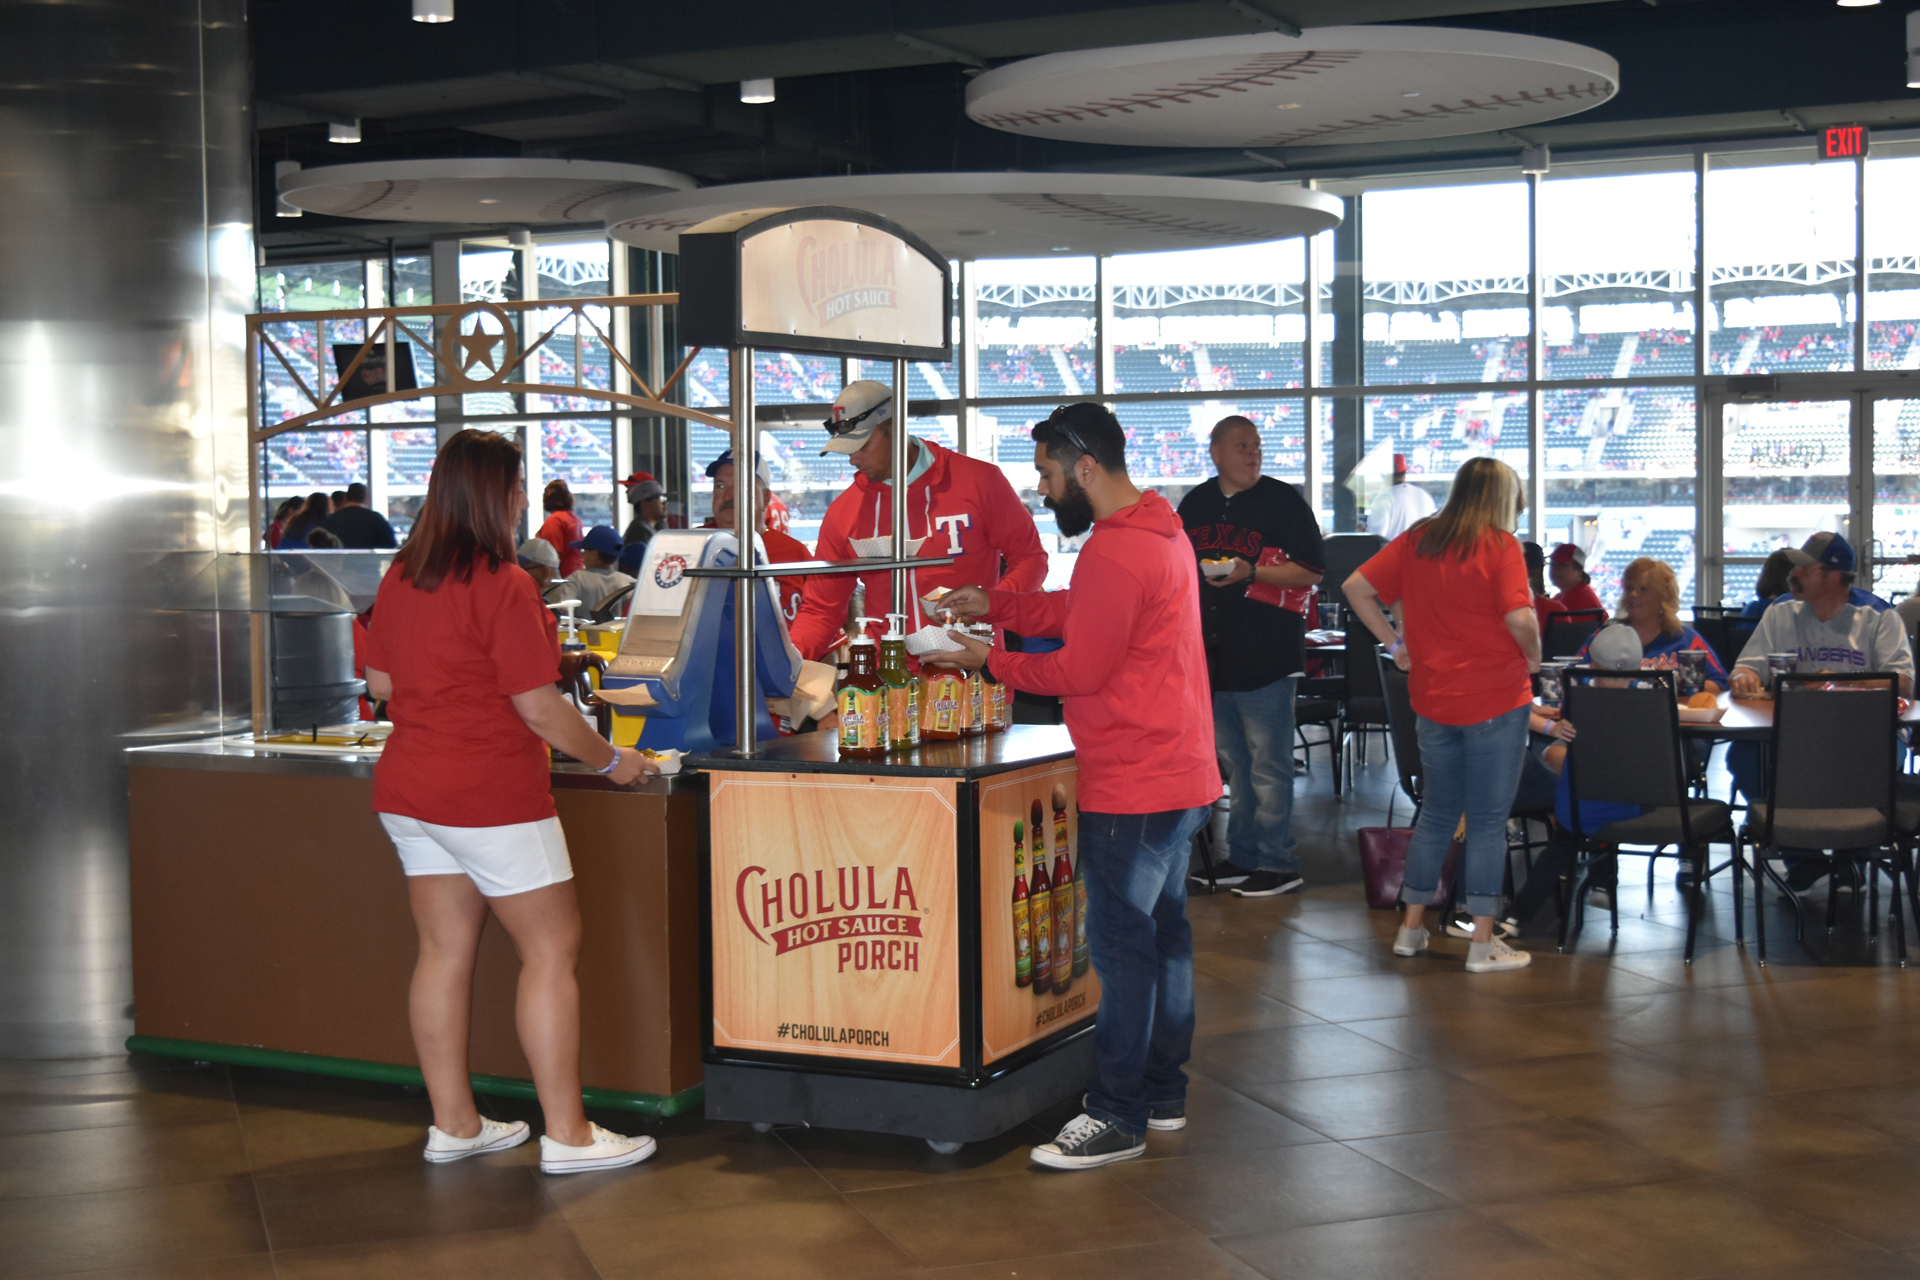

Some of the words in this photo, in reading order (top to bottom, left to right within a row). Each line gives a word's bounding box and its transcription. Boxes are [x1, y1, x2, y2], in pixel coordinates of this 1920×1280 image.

[1826, 126, 1863, 157] EXIT
[796, 236, 897, 319] CHOLULA
[826, 294, 851, 320] HOT
[854, 290, 890, 308] SAUCE
[832, 405, 846, 422] T
[935, 513, 972, 557] T
[1786, 647, 1866, 667] ANGERS
[736, 865, 919, 945] CHOLULA
[787, 920, 832, 948] HOT
[838, 917, 909, 936] SAUCE
[838, 940, 919, 973] PORCH
[1035, 991, 1086, 1028] #CHOLULAPORCH
[777, 1022, 889, 1047] #CHOLULAPORCH
